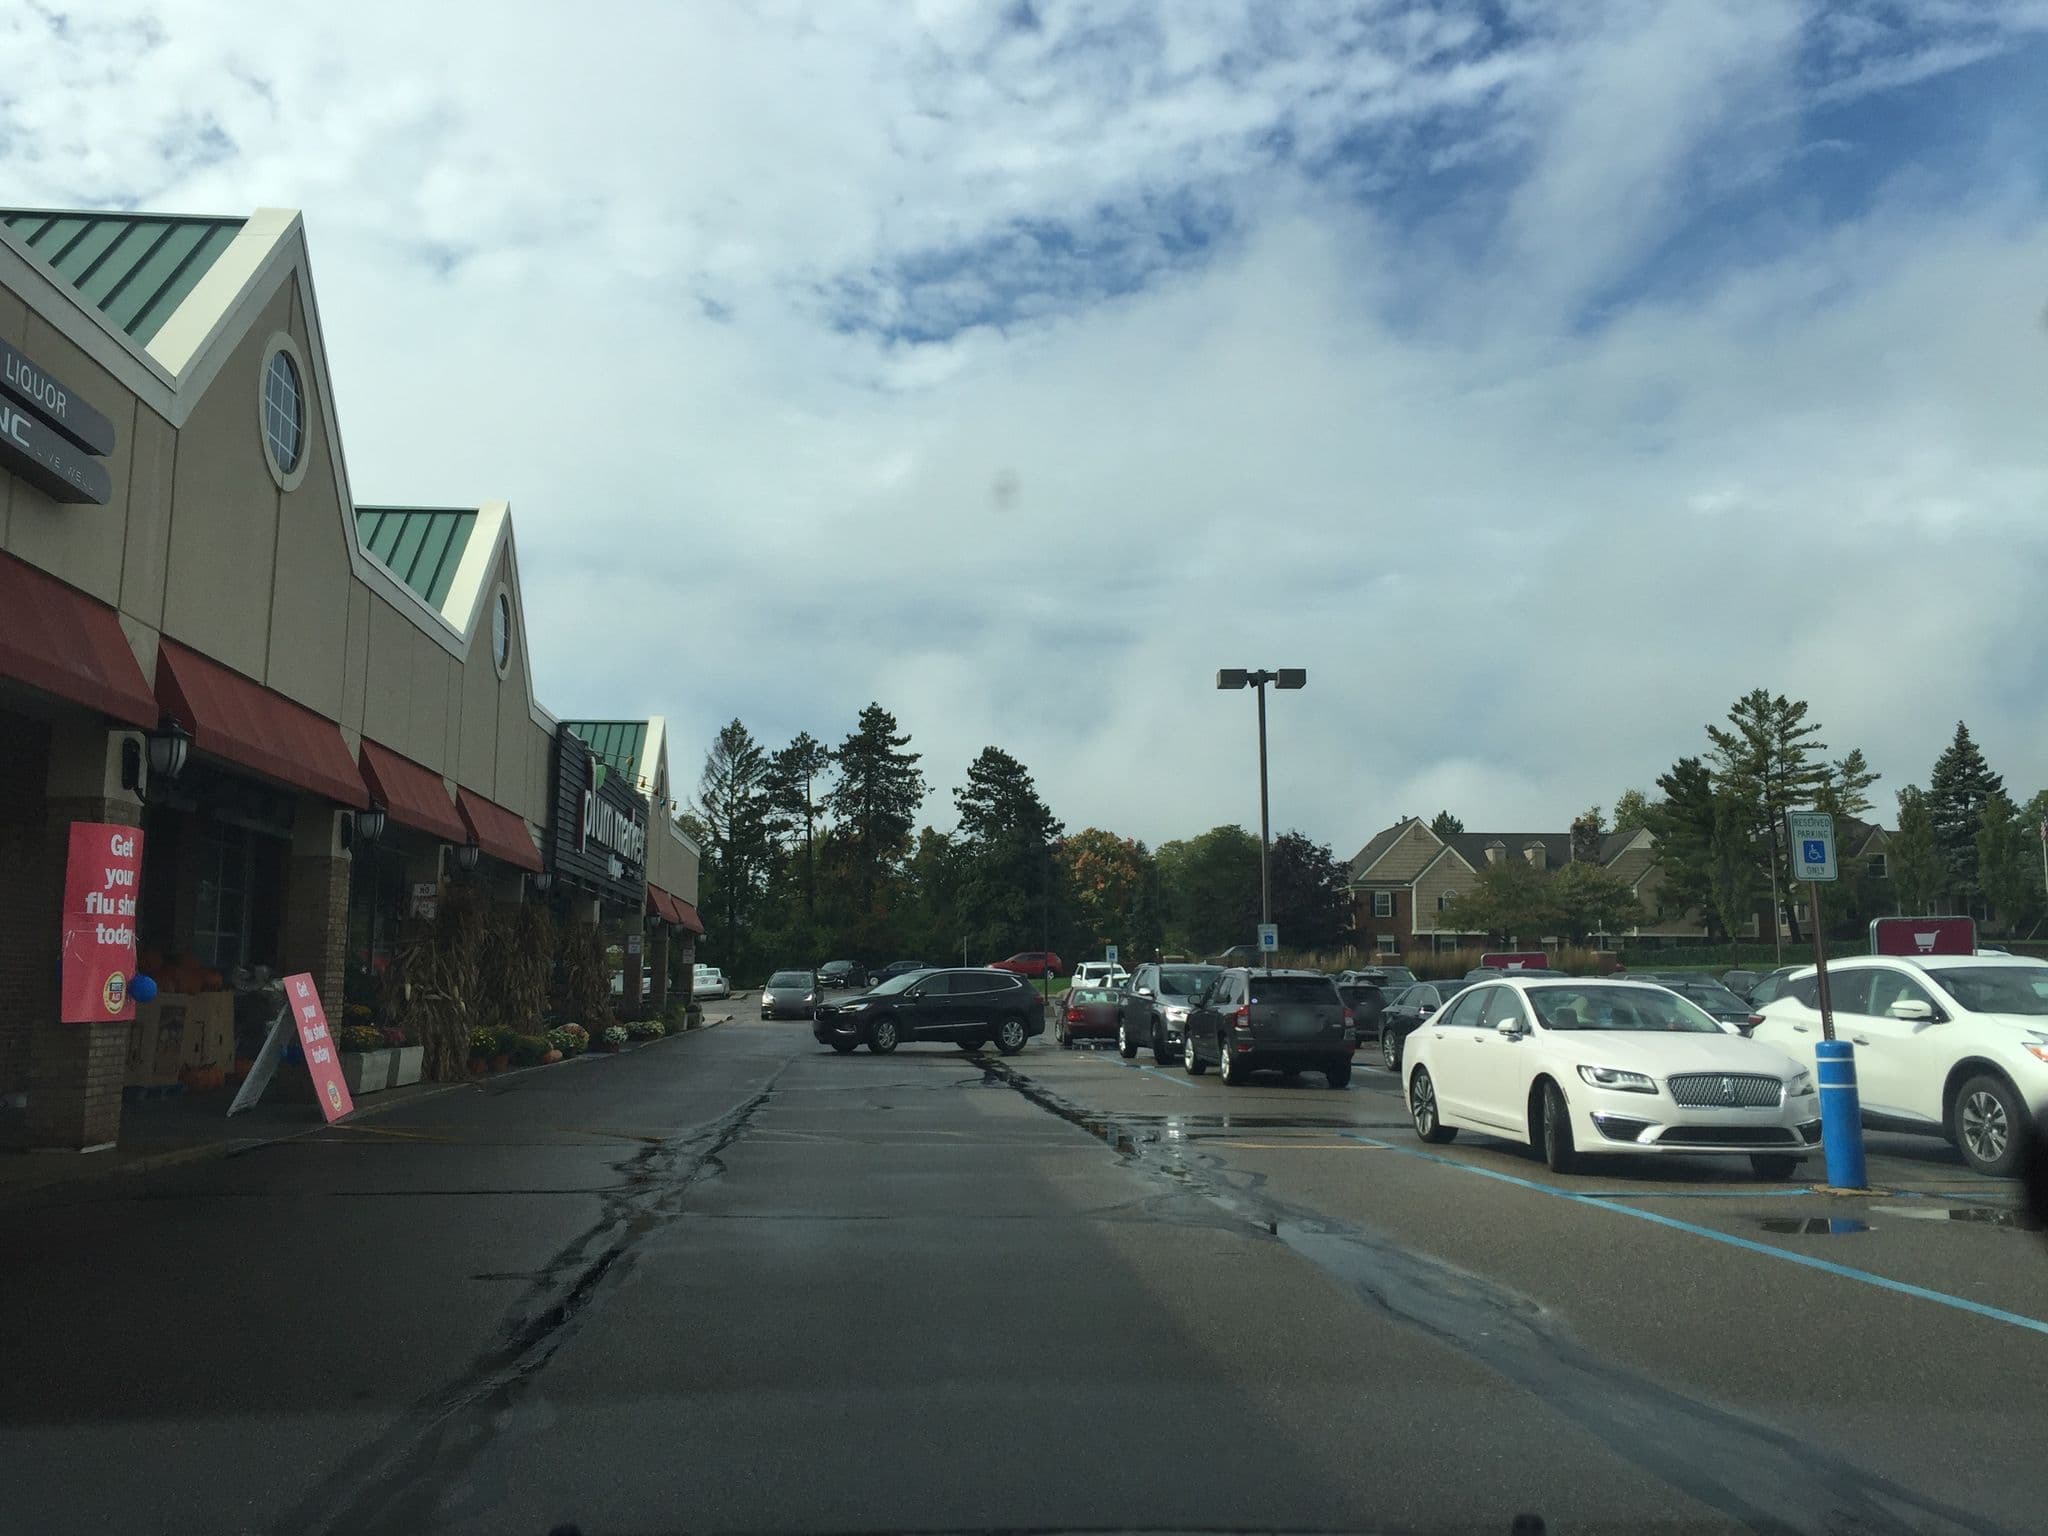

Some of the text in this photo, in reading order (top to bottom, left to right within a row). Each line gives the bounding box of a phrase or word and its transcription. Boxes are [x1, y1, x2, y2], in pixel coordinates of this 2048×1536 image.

[6, 353, 67, 418] LIQUOR
[1794, 817, 1830, 827] RESERVED
[1797, 830, 1830, 838] PARKING
[111, 834, 134, 858] Get
[104, 867, 134, 889] your
[1807, 866, 1825, 875] ONLY
[85, 892, 114, 914] flu
[96, 923, 132, 949] today
